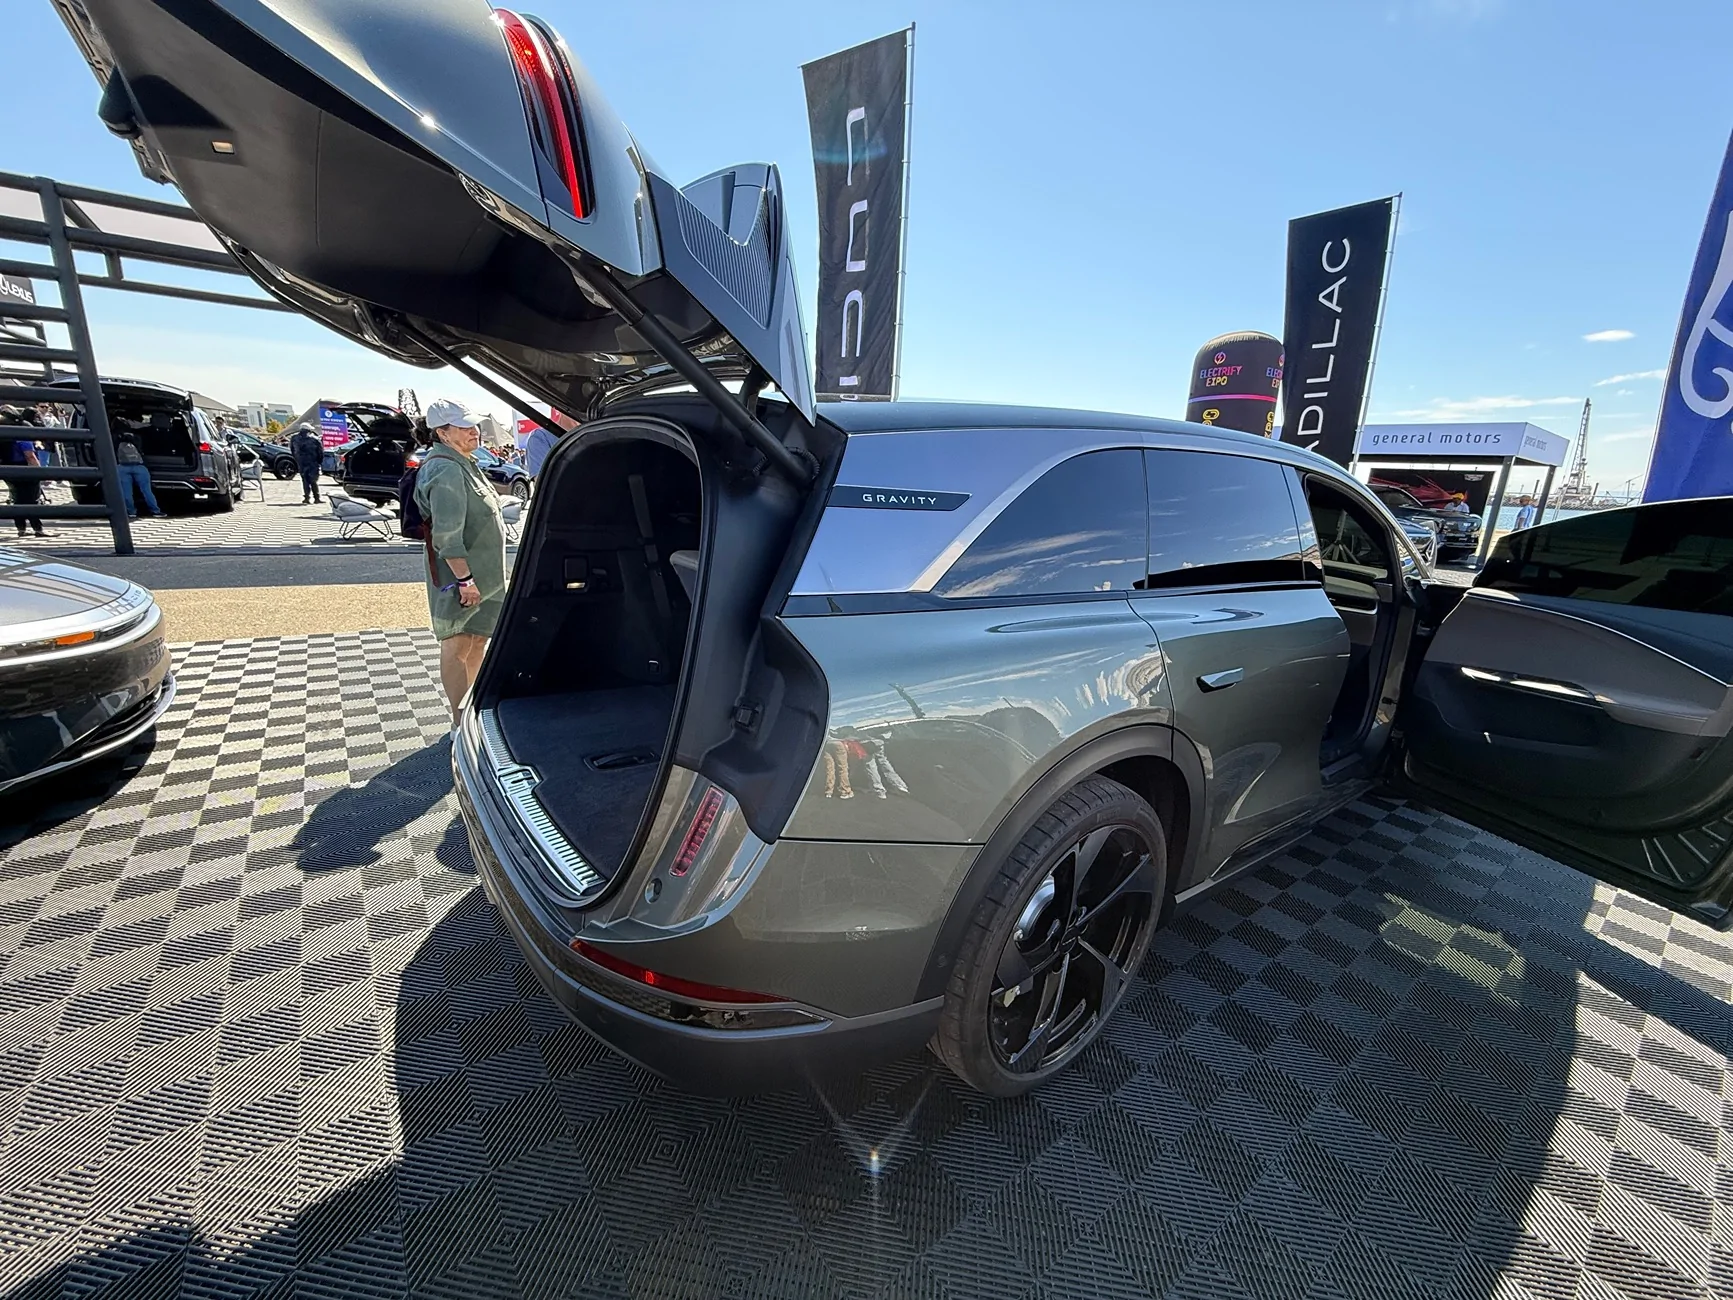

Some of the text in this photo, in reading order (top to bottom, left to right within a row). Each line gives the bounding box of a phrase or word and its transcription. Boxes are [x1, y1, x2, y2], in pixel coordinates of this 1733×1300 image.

[839, 106, 868, 402] LUCI
[6, 280, 34, 304] LEXUS
[1298, 237, 1351, 452] DILLAC
[1200, 365, 1242, 379] ELECTRIFY
[1205, 376, 1228, 387] EXPO
[1372, 431, 1502, 446] general motors
[862, 493, 937, 505] GRAVITY
